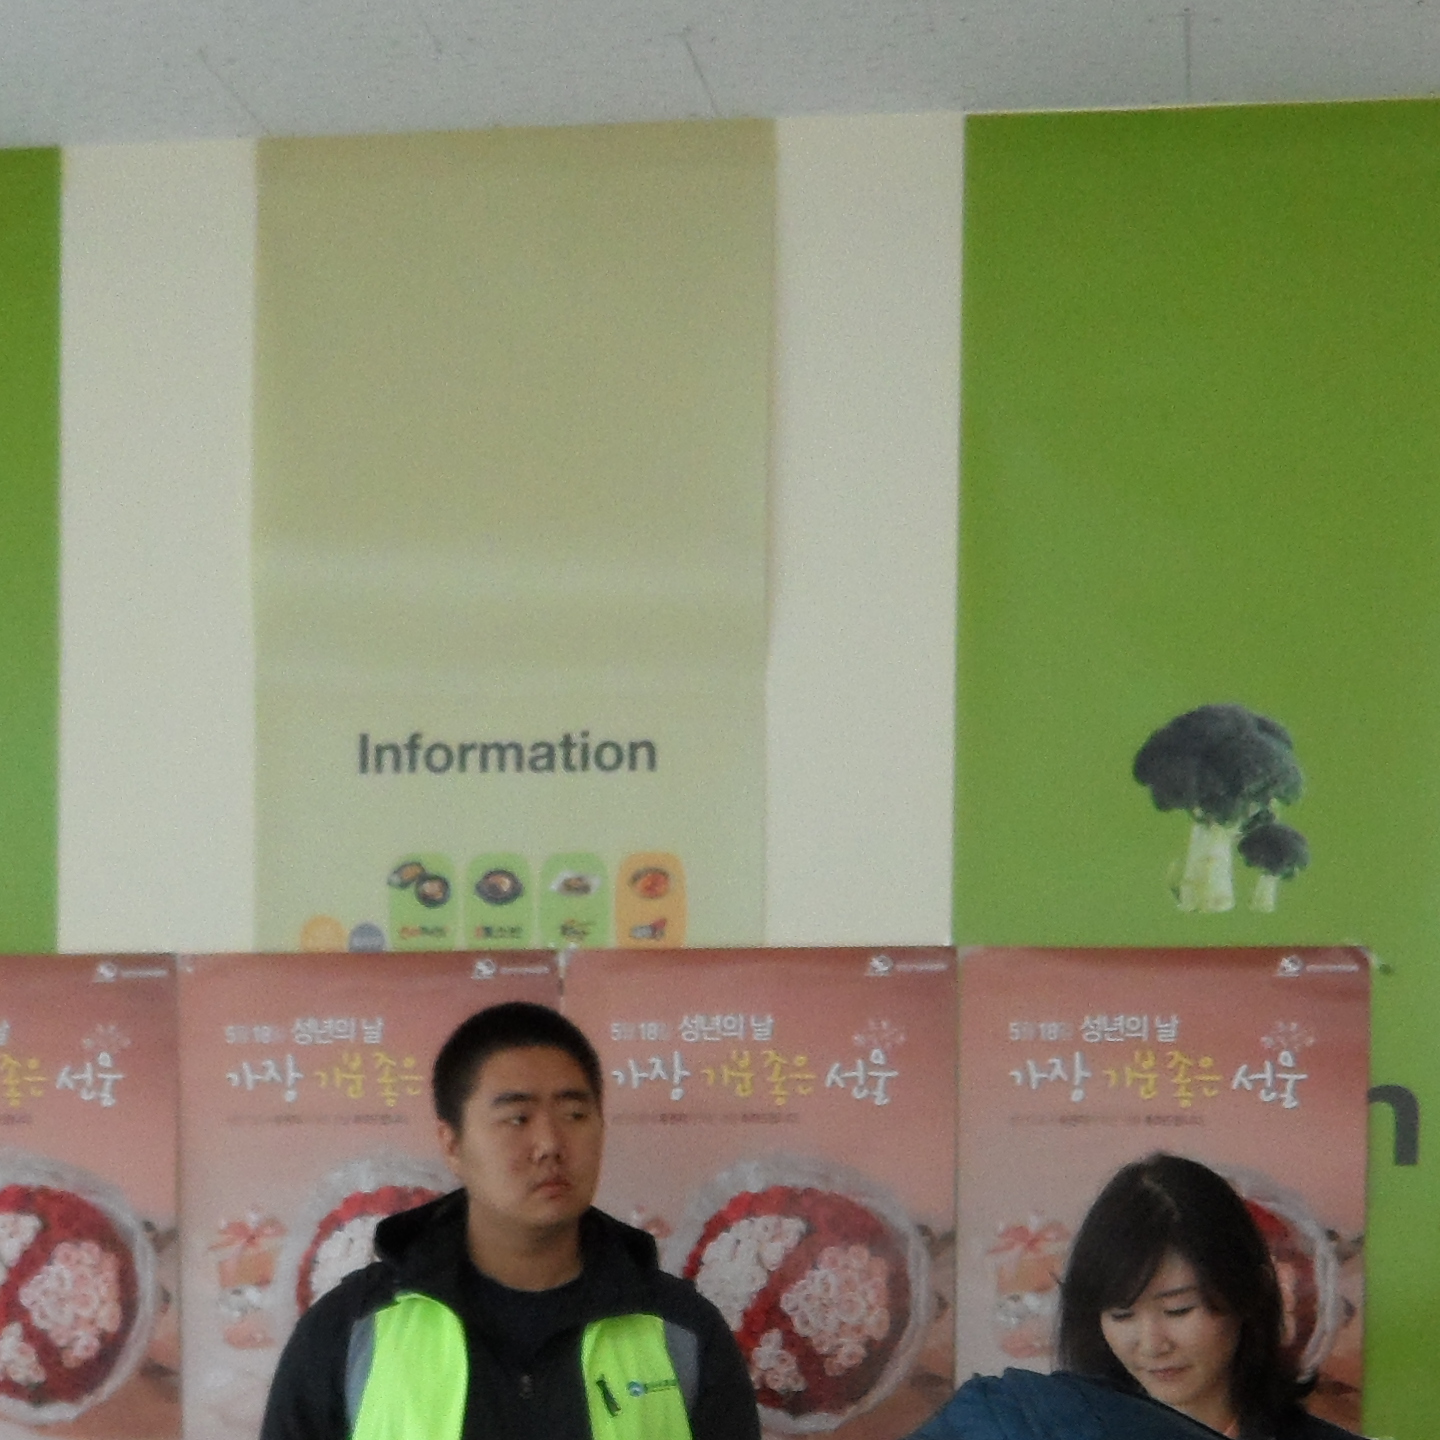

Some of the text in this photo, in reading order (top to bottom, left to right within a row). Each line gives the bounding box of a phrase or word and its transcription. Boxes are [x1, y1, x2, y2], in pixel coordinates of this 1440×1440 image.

[358, 731, 657, 773] Information
[226, 1054, 304, 1102] 가장
[612, 1050, 691, 1100] 가장
[1009, 1051, 1092, 1102] 가장
